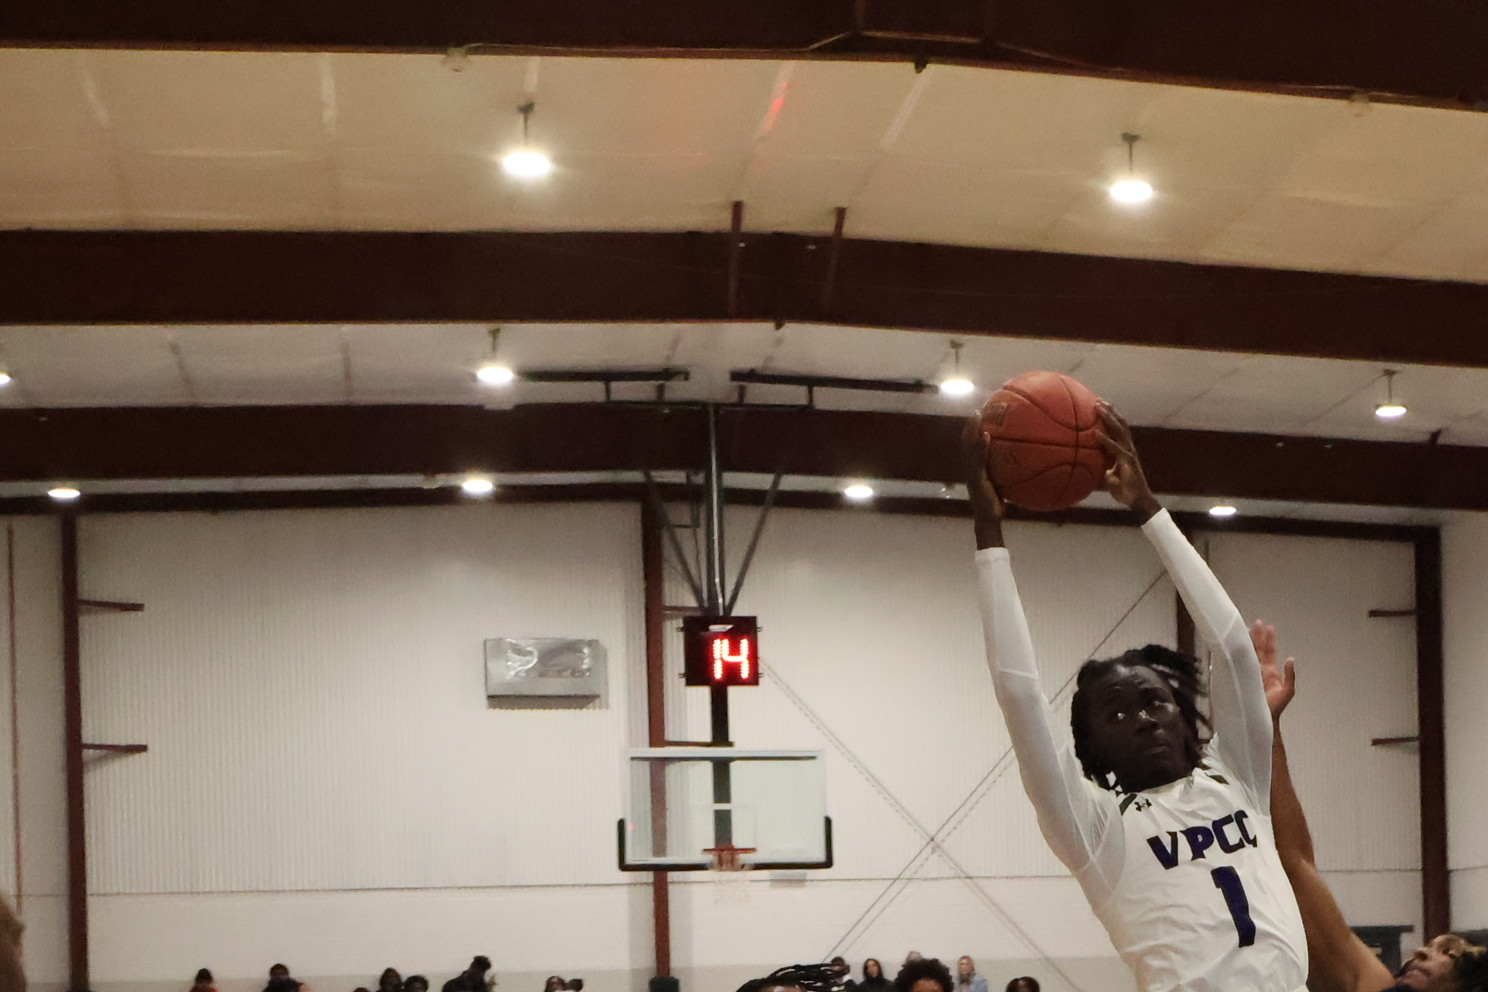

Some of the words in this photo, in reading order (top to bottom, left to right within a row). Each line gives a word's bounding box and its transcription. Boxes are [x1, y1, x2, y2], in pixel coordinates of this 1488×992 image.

[713, 638, 749, 679] 14
[1146, 810, 1258, 870] VPCC
[1210, 866, 1257, 948] 1
